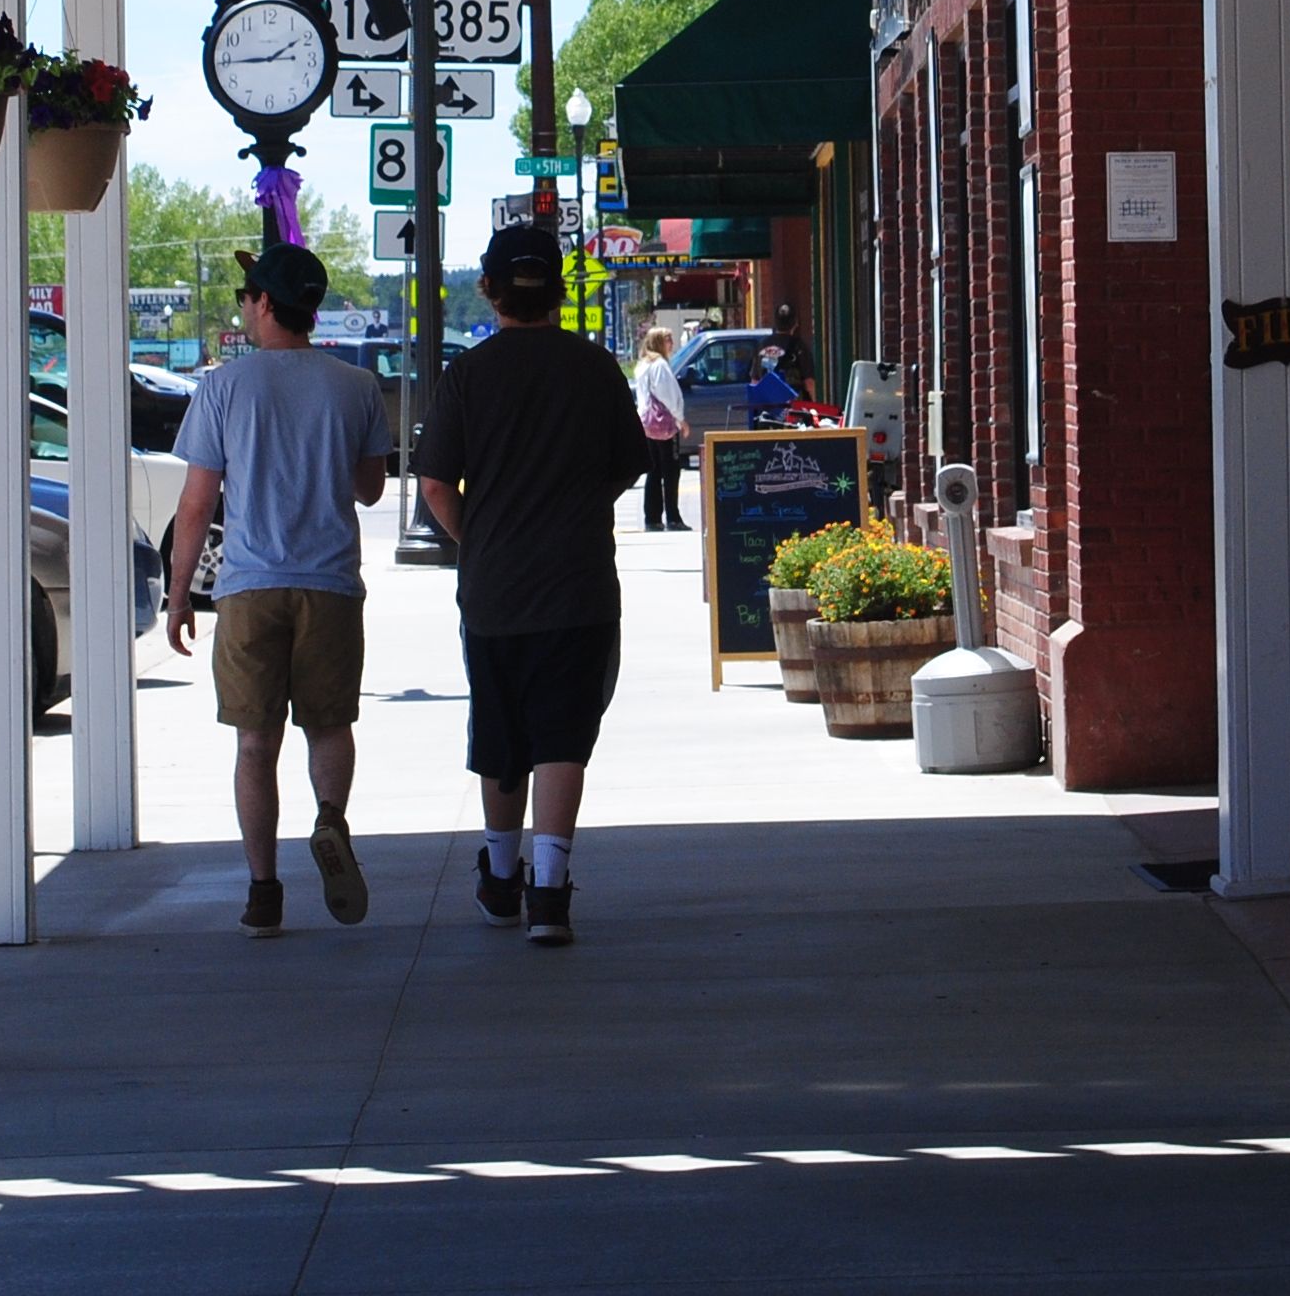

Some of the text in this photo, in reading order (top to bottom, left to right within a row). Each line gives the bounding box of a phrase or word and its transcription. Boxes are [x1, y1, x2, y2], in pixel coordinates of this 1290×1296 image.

[241, 16, 252, 32] 11
[262, 9, 278, 25] 12
[435, 0, 510, 43] 385
[225, 32, 240, 47] 10
[303, 31, 313, 47] 2
[307, 52, 317, 68] 3
[228, 74, 239, 89] 8
[244, 90, 253, 105] 7
[264, 94, 275, 110] 6
[287, 88, 297, 105] 5
[543, 159, 561, 174] 5TH
[557, 206, 578, 225] 85
[561, 312, 598, 323] AHAD
